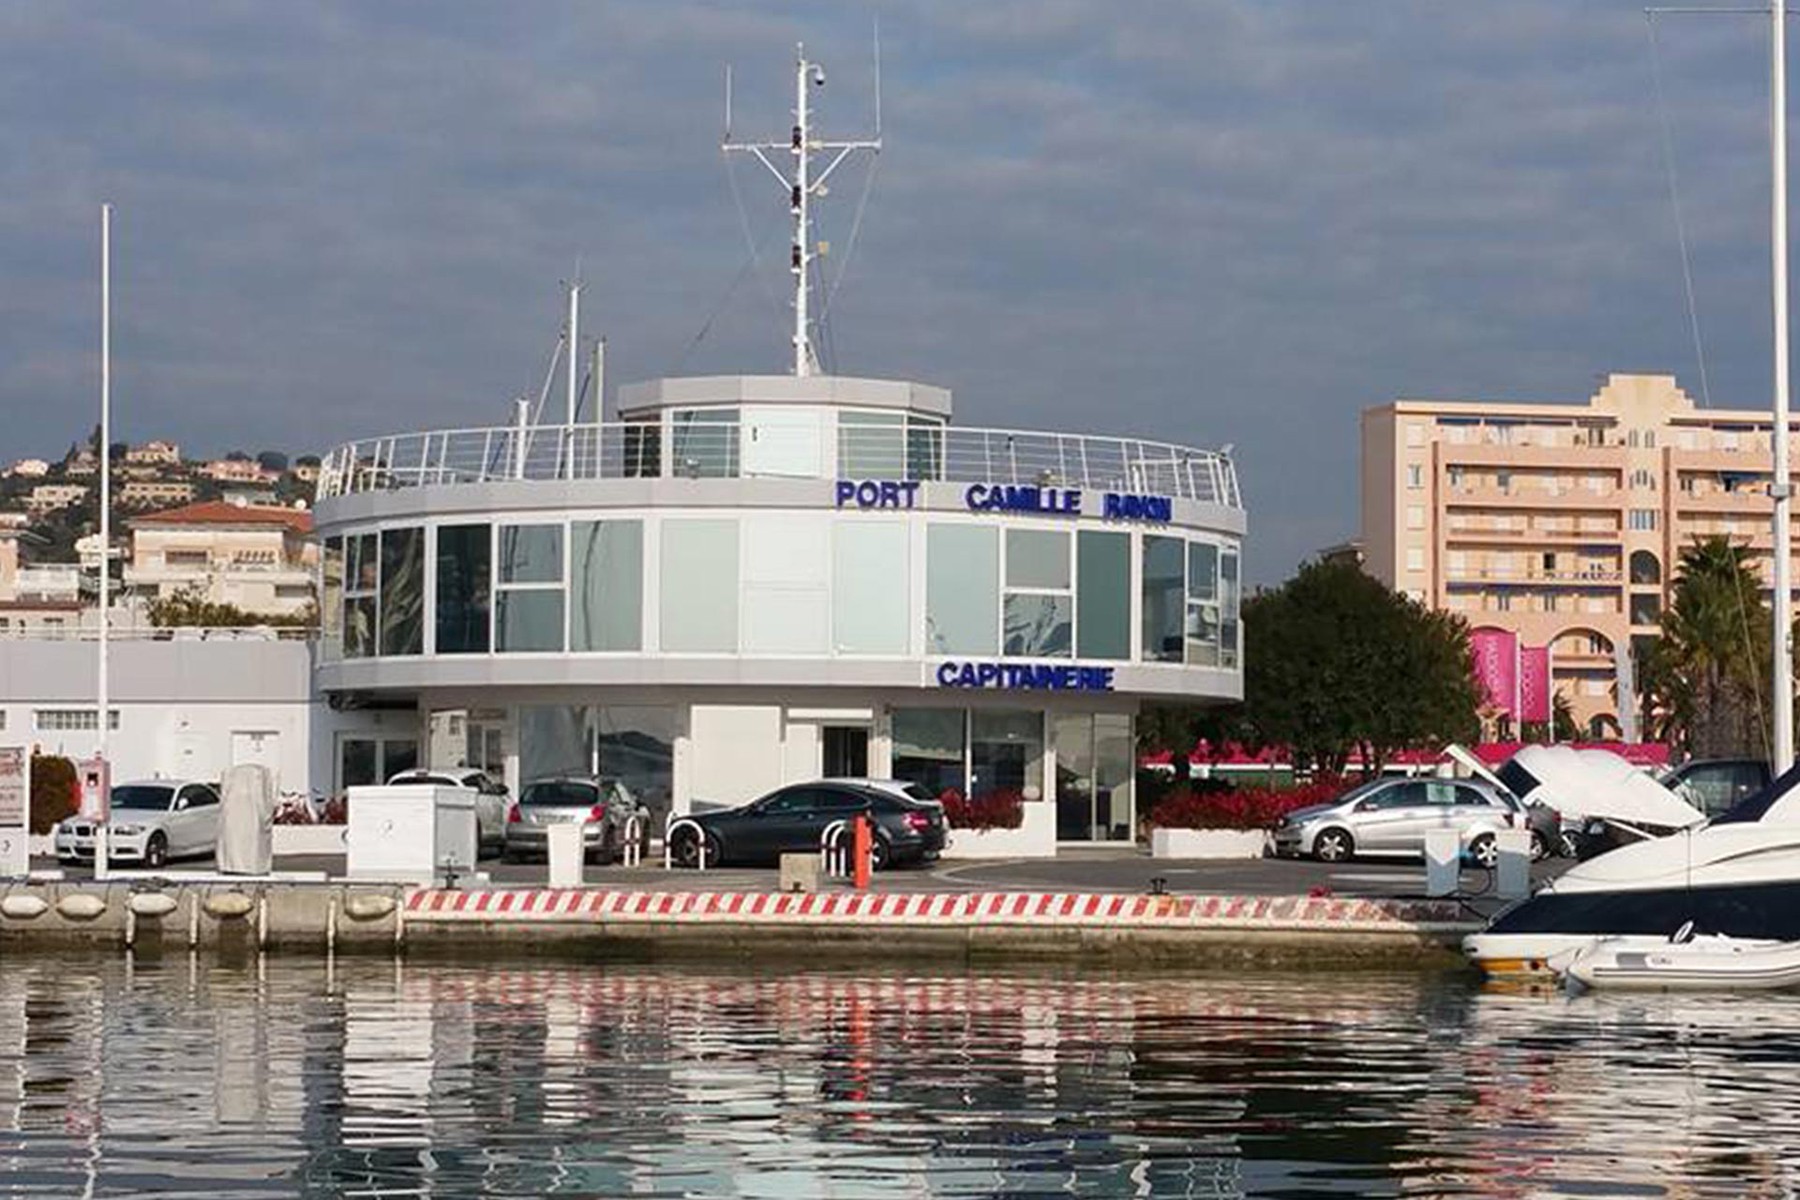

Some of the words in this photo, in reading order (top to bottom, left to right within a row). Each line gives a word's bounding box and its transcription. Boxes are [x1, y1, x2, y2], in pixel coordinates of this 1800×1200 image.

[836, 481, 919, 508] PORT
[966, 485, 1081, 514] CAMILLE
[937, 662, 1115, 691] CAPITAINERIE
